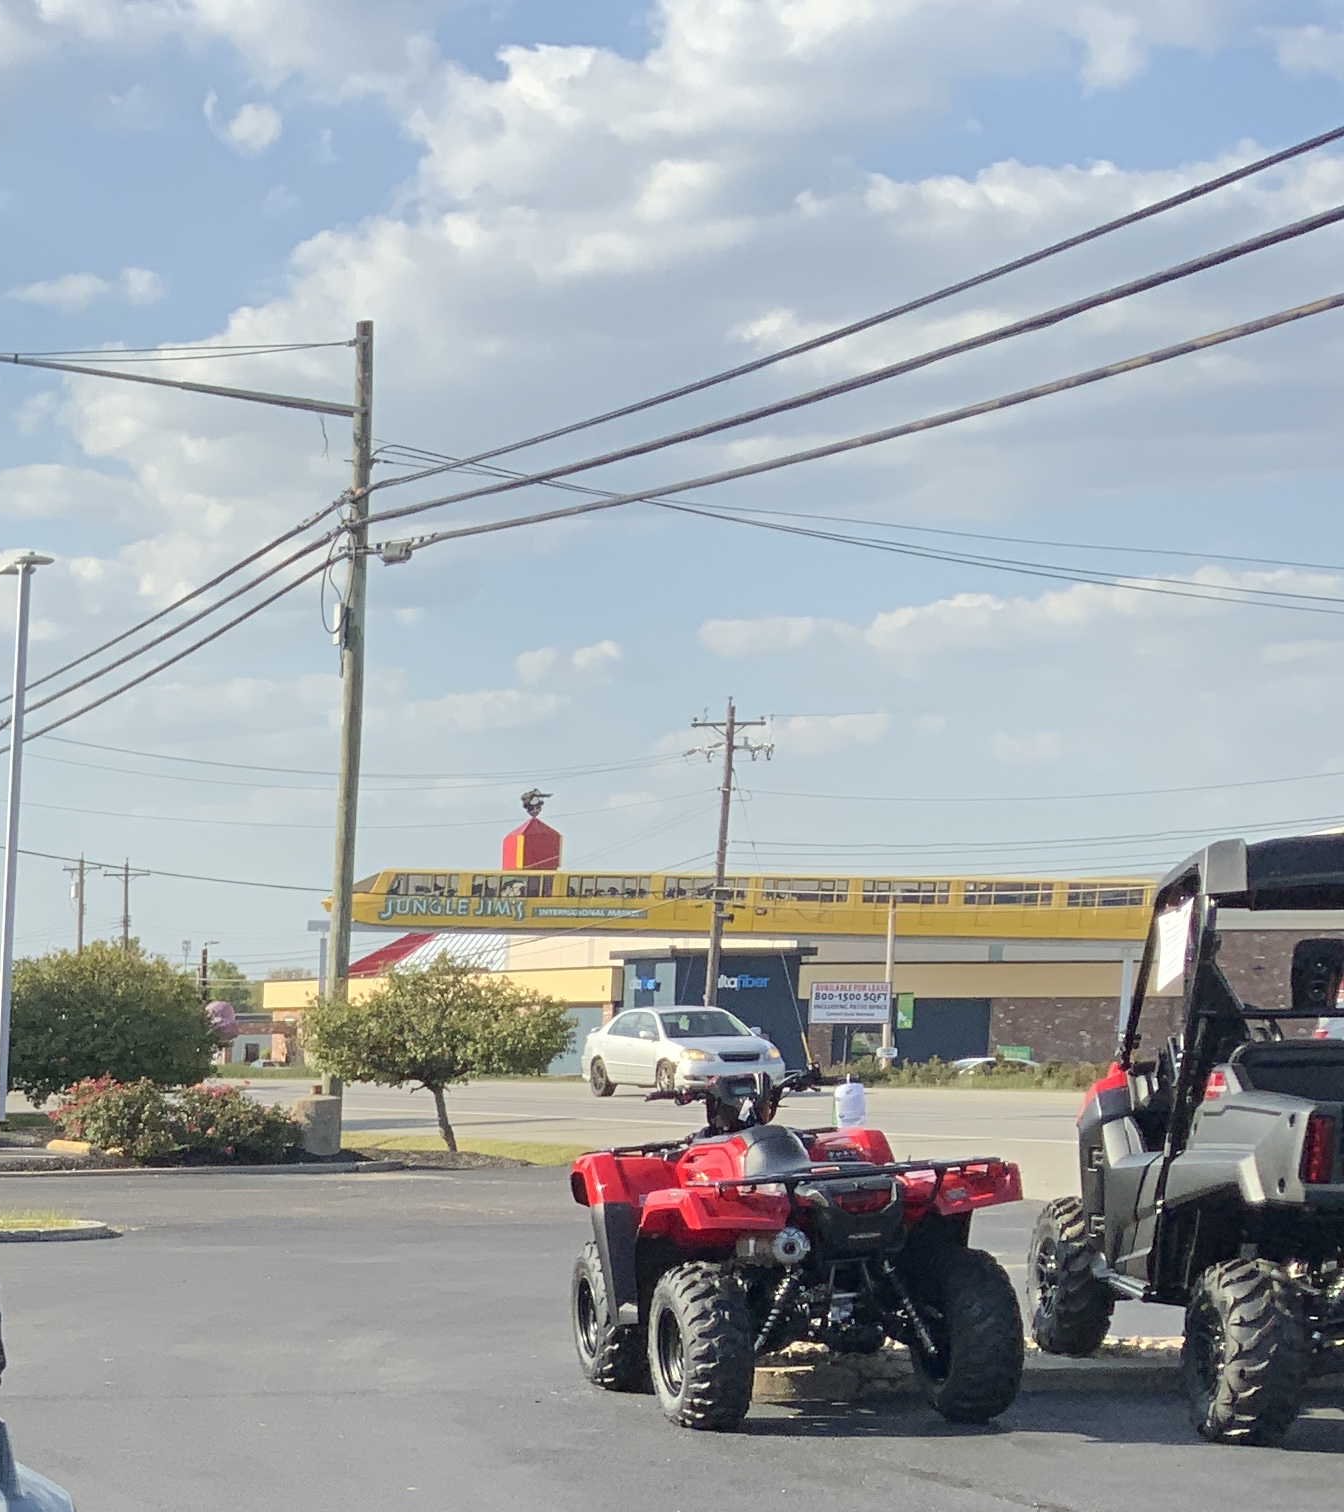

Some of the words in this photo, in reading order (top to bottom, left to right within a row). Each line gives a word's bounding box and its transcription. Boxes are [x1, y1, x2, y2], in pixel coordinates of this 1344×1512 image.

[378, 896, 469, 920] JUNGLE
[718, 974, 769, 991] ltafiber
[815, 984, 853, 992] AVAILABLE
[853, 984, 867, 992] FOR
[868, 984, 889, 992] LEASE
[814, 992, 862, 1001] 800-1500
[863, 993, 888, 1003] SQFT
